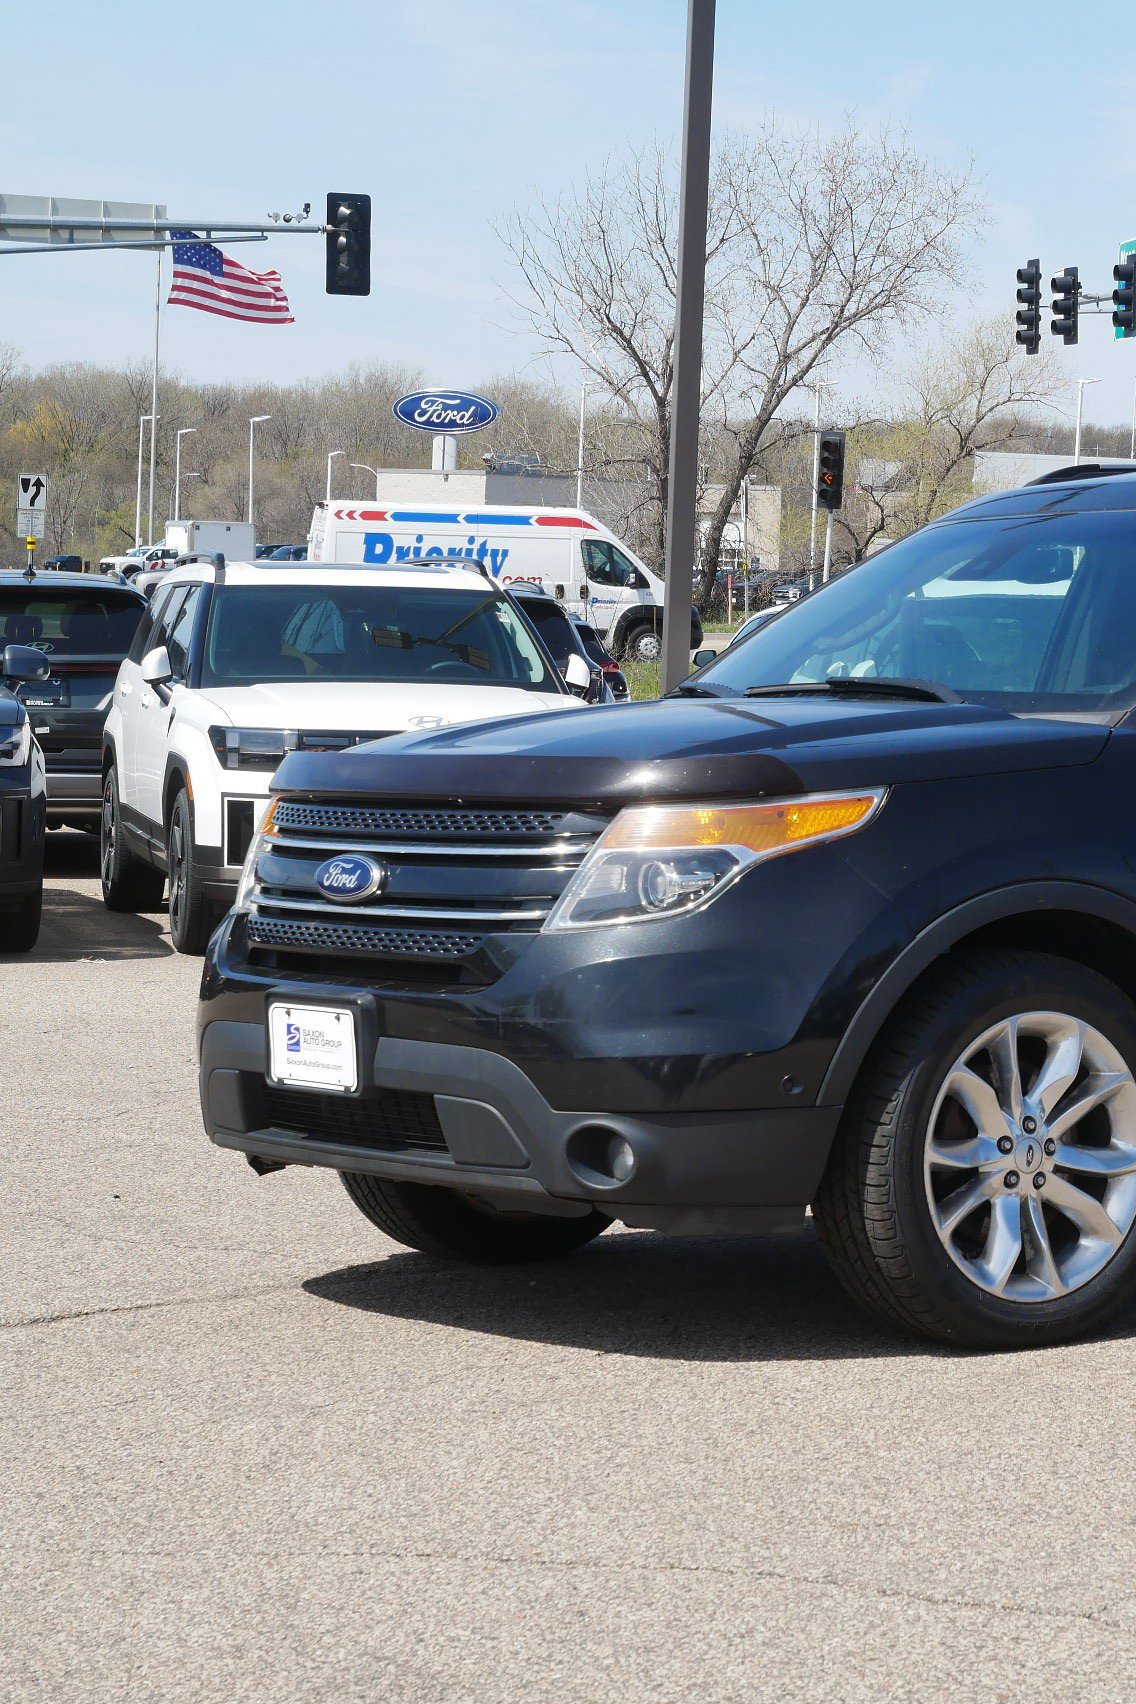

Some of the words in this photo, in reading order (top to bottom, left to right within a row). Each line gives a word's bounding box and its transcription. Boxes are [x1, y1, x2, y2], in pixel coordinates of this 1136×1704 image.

[414, 397, 476, 424] Ford
[323, 861, 361, 888] Ford
[302, 1029, 324, 1038] SAXON
[303, 1037, 319, 1046] AUTO
[320, 1039, 343, 1048] GROUP
